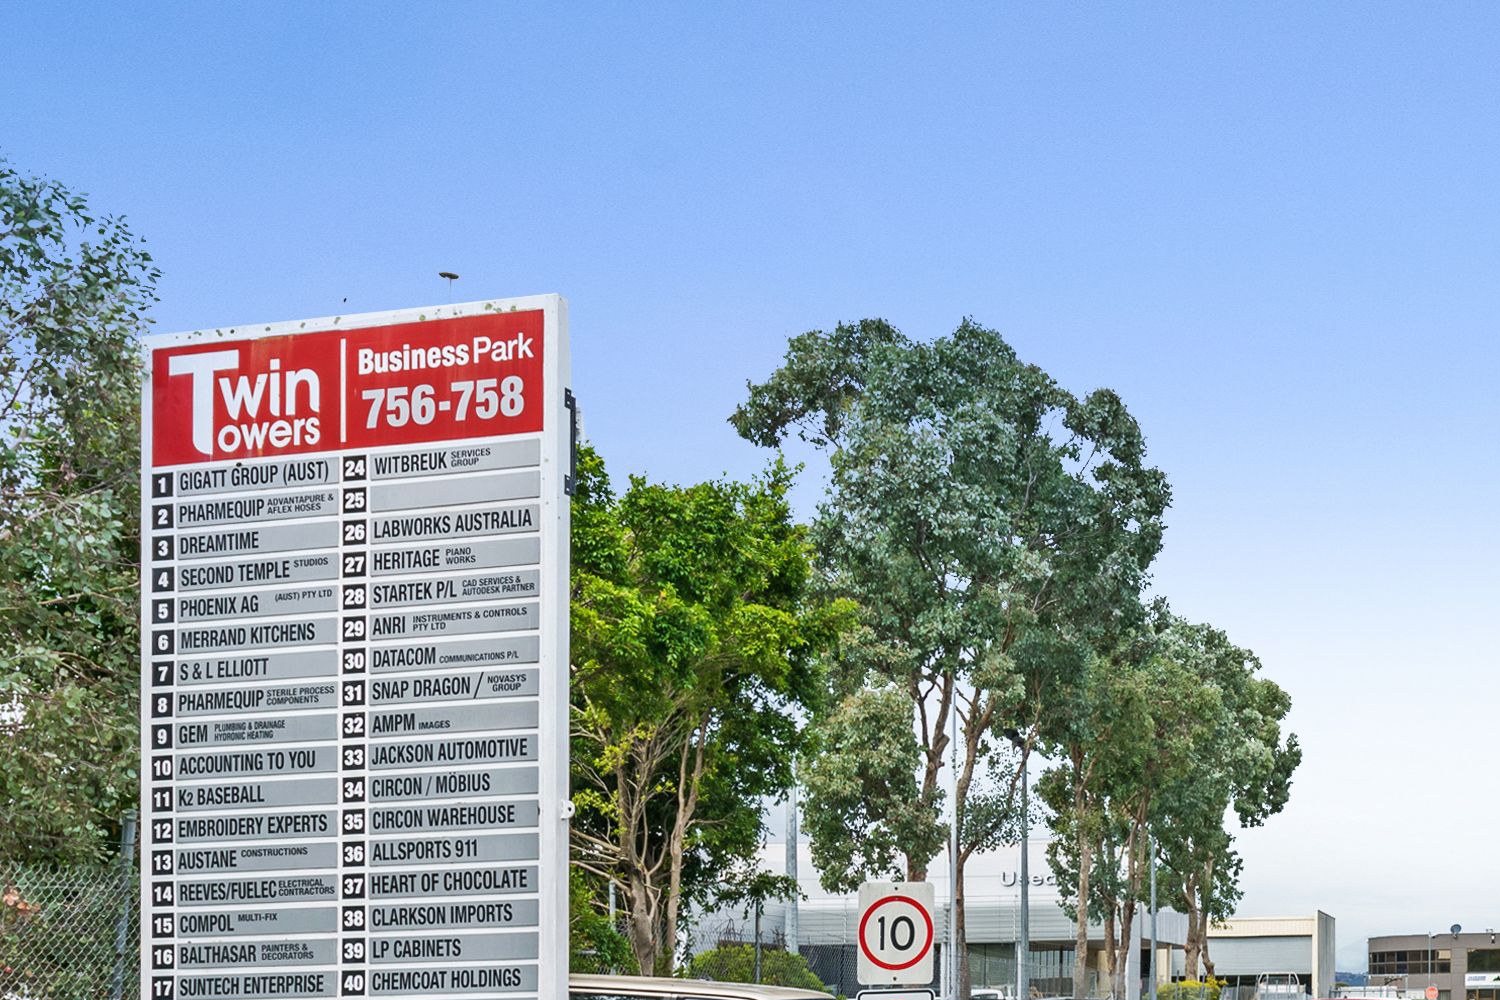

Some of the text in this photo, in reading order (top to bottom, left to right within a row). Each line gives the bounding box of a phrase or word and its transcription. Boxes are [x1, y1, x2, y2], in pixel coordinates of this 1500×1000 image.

[359, 333, 534, 376] Business Park
[169, 349, 320, 455] Twin
[362, 376, 525, 429] 756-758
[375, 452, 447, 475] WITBREUK
[451, 448, 491, 459] SERVICES
[451, 458, 479, 467] GROUP
[180, 461, 328, 490] GIGATT GROUP (AUST)
[267, 503, 321, 514] AFLEX HOSES
[268, 494, 325, 506] ADVANTAPURE
[180, 499, 265, 522] PHARMEQUIP
[374, 509, 532, 539] LABWORKS AUSTRALIA
[181, 532, 259, 554] DREAMTIME
[446, 547, 471, 556] PIANO
[374, 549, 440, 570] HERITAGE
[446, 555, 476, 565] WORKS
[181, 558, 328, 586] SECOND TEMPLE STUDIOS
[462, 578, 477, 588] CAD
[479, 576, 513, 586] SERVICES
[275, 589, 332, 602] (AUST) PTY LTD
[373, 580, 457, 603] STARTEK P/L
[462, 583, 535, 596] AUTODESK PARTNER
[181, 595, 258, 617] PHOENIX AG
[413, 607, 527, 623] INSTRUMENTS & CONTROLS
[373, 616, 406, 635] ANRI
[413, 622, 445, 631] PTY LTD
[181, 623, 315, 649] MERRAND KITCHENS
[373, 647, 519, 667] DATACOM COMMUNICATIONS P/L
[180, 658, 269, 680] S & L ELLIOTT
[488, 674, 527, 684] NOVASYS
[267, 686, 334, 697] STERILE PROCESS
[372, 676, 470, 700] SNAP DRAGON
[493, 683, 521, 692] GROUP
[179, 690, 264, 712] PHARMEQUIP
[267, 695, 319, 705] COMPONENTS
[372, 713, 450, 733] AMPM IMAGES
[179, 725, 208, 743] GEM
[372, 738, 527, 765] JACKSON AUTOMOTIVE
[179, 750, 315, 775] ACCOUNTING TO YOU
[179, 785, 264, 806] K2 BASEBALL
[373, 777, 422, 797] CIRCON
[179, 814, 327, 838] EMBROIDERY EXPERTS
[373, 805, 515, 829] CIRCON WAREHOUSE
[178, 847, 308, 869] AUSTANE CONSTRUCTIONS
[373, 839, 477, 861] ALLSPORTS 911
[180, 881, 277, 901] REEVES/FUELEC
[279, 879, 324, 888] ELECTRICAL
[279, 886, 335, 896] CONTRACTORS
[372, 869, 527, 894] HEART OF CHOCOLATE
[180, 913, 277, 933] COMPOL MULTI-FIX
[373, 903, 512, 926] CLARKSON IMPORTS
[878, 916, 915, 950] 10
[181, 944, 256, 964] BALTHASAR
[262, 944, 299, 952] PAINTERS
[262, 951, 314, 961] DECORATORS
[373, 939, 461, 958] LP CABINETS
[180, 975, 323, 996] SUNTECH ENTERPRISE
[373, 968, 521, 990] CHEMCOAT HOLDINGS
